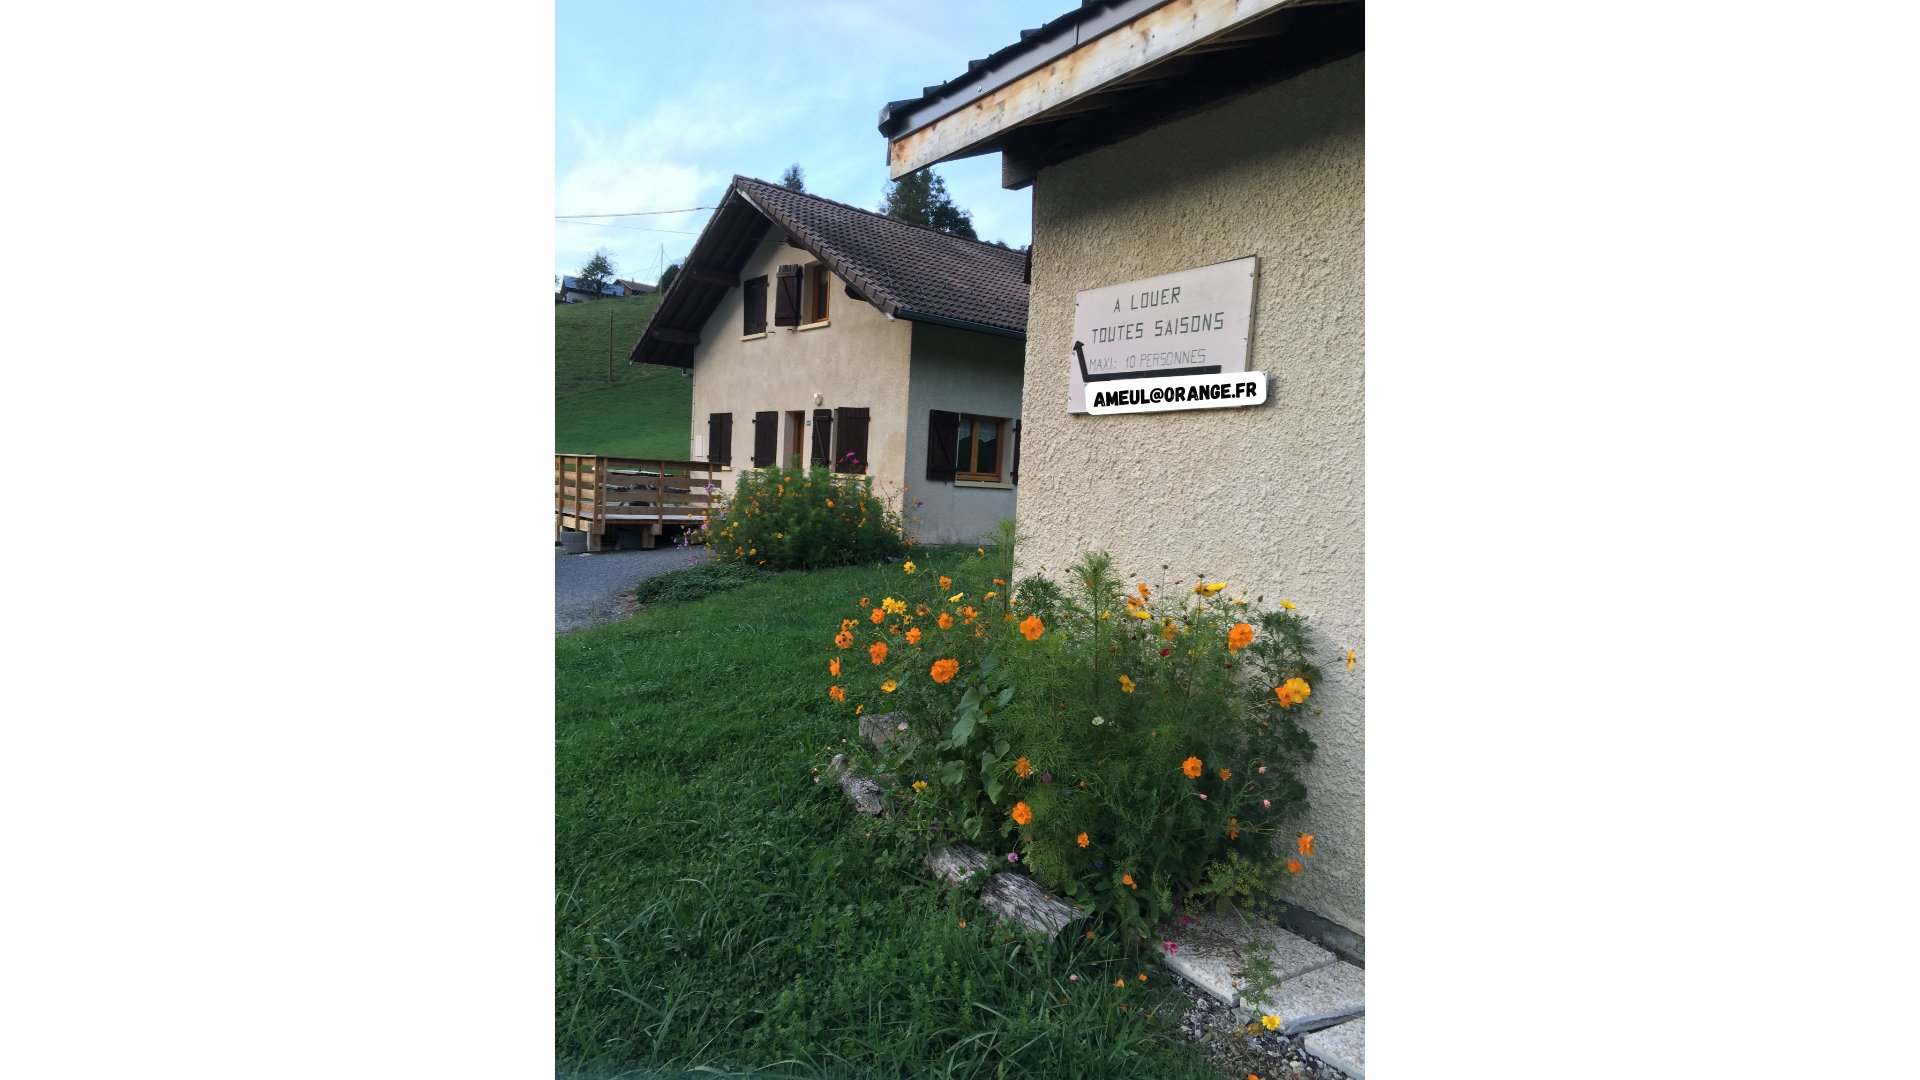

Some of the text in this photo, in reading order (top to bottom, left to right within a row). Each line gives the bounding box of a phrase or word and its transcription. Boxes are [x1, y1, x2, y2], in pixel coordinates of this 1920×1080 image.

[1114, 287, 1180, 313] A LOUER
[1092, 312, 1224, 344] TOUTES SAISONS
[1089, 349, 1206, 371] MAXI: 10 PERSONNES
